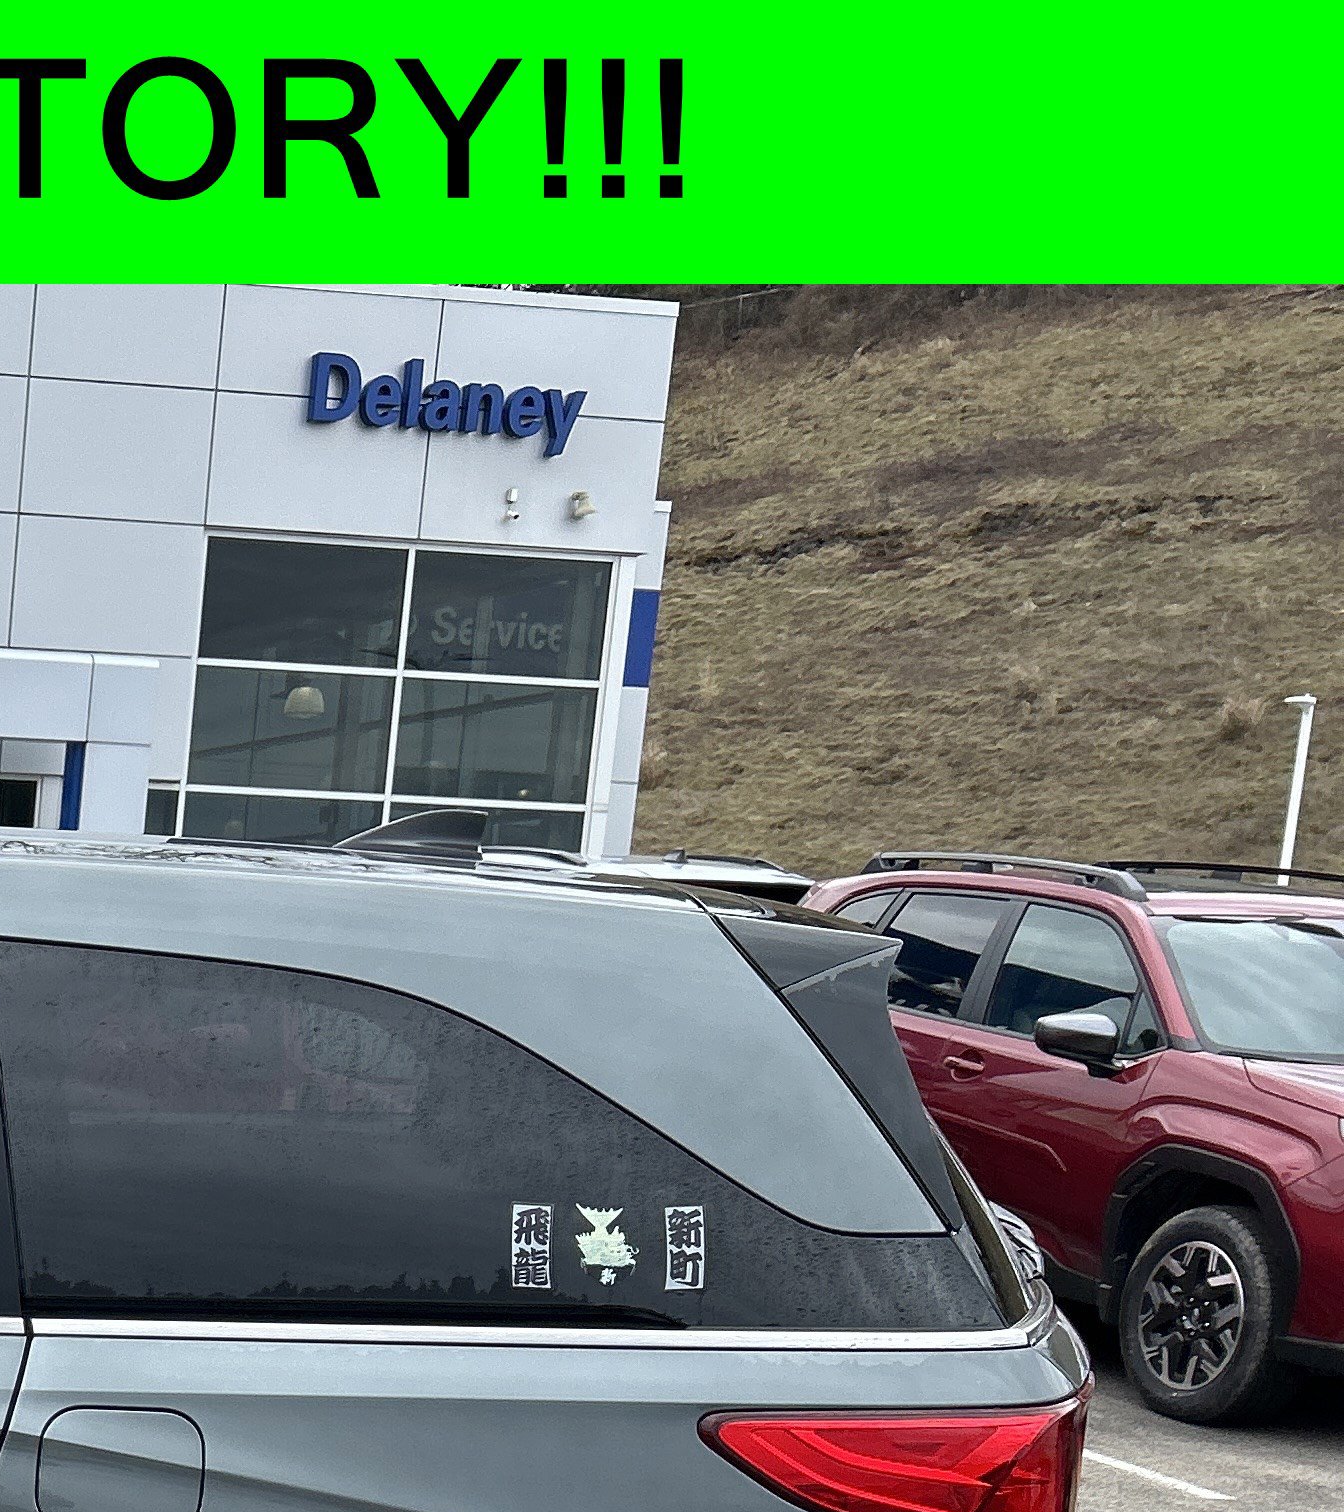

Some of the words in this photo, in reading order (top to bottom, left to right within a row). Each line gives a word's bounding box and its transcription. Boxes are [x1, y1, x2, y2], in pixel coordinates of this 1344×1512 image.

[307, 352, 588, 458] Delaney
[513, 1207, 550, 1286] 飛龍
[667, 1209, 703, 1287] 新町
